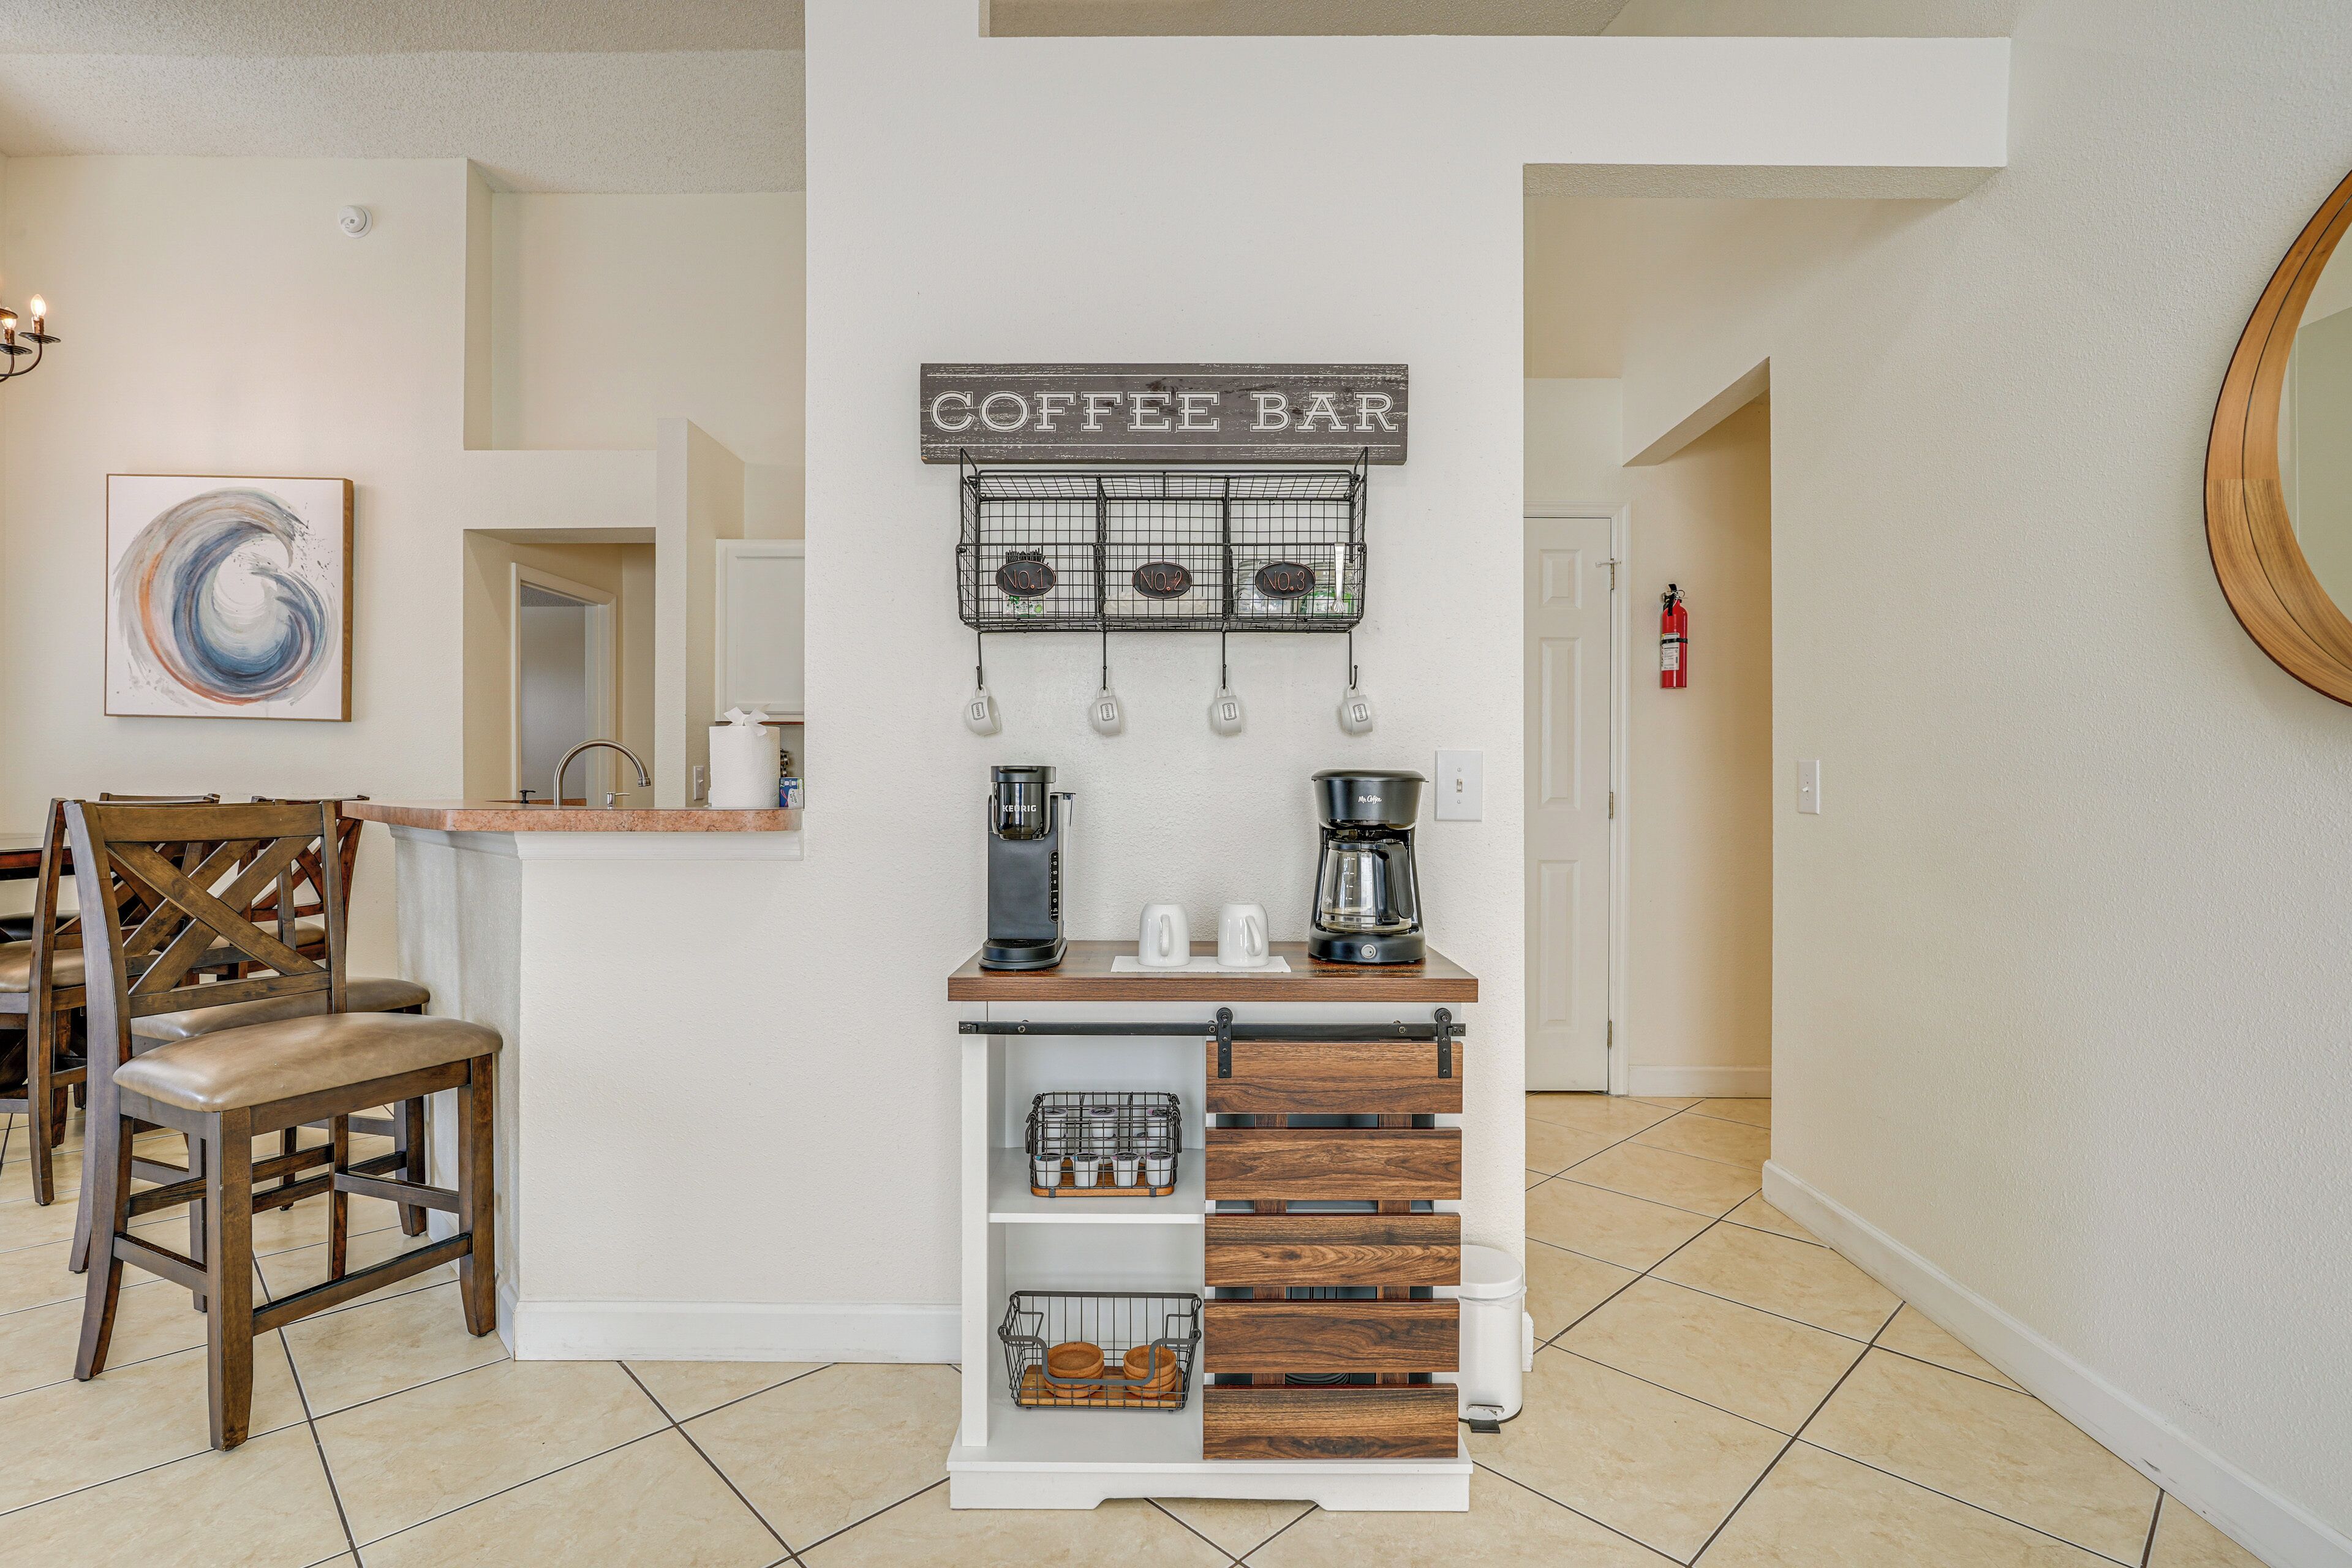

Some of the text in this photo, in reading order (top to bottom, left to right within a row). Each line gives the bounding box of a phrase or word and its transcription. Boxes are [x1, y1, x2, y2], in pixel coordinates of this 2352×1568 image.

[930, 390, 1399, 432] COFFEE BAR
[1003, 567, 1047, 590] NO.1
[1140, 570, 1183, 592] NO.2
[1263, 570, 1305, 592] NO.3
[1366, 794, 1382, 805] Coffee
